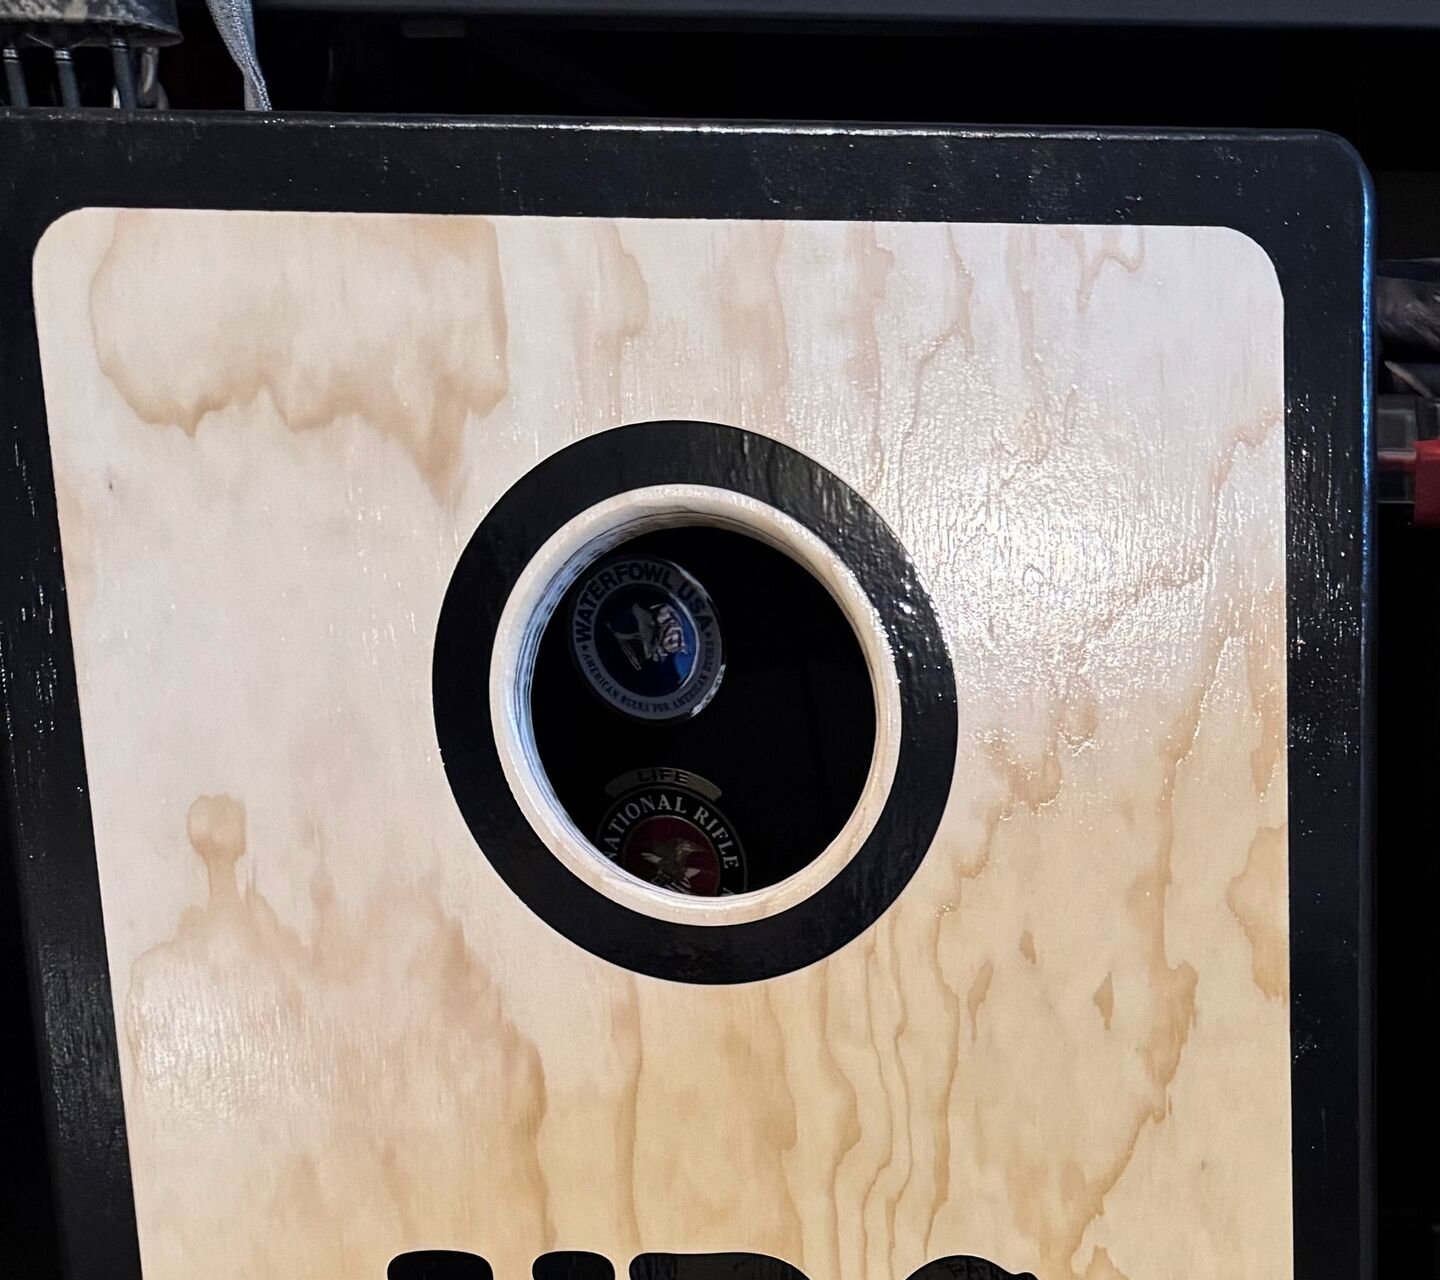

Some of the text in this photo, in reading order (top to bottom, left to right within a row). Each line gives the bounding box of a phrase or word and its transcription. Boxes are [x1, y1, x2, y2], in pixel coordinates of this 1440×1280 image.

[576, 562, 713, 642] WATERFOWL USA
[583, 654, 617, 699] AMERICAN
[638, 769, 689, 785] LIFE
[693, 806, 740, 869] RIFLE
